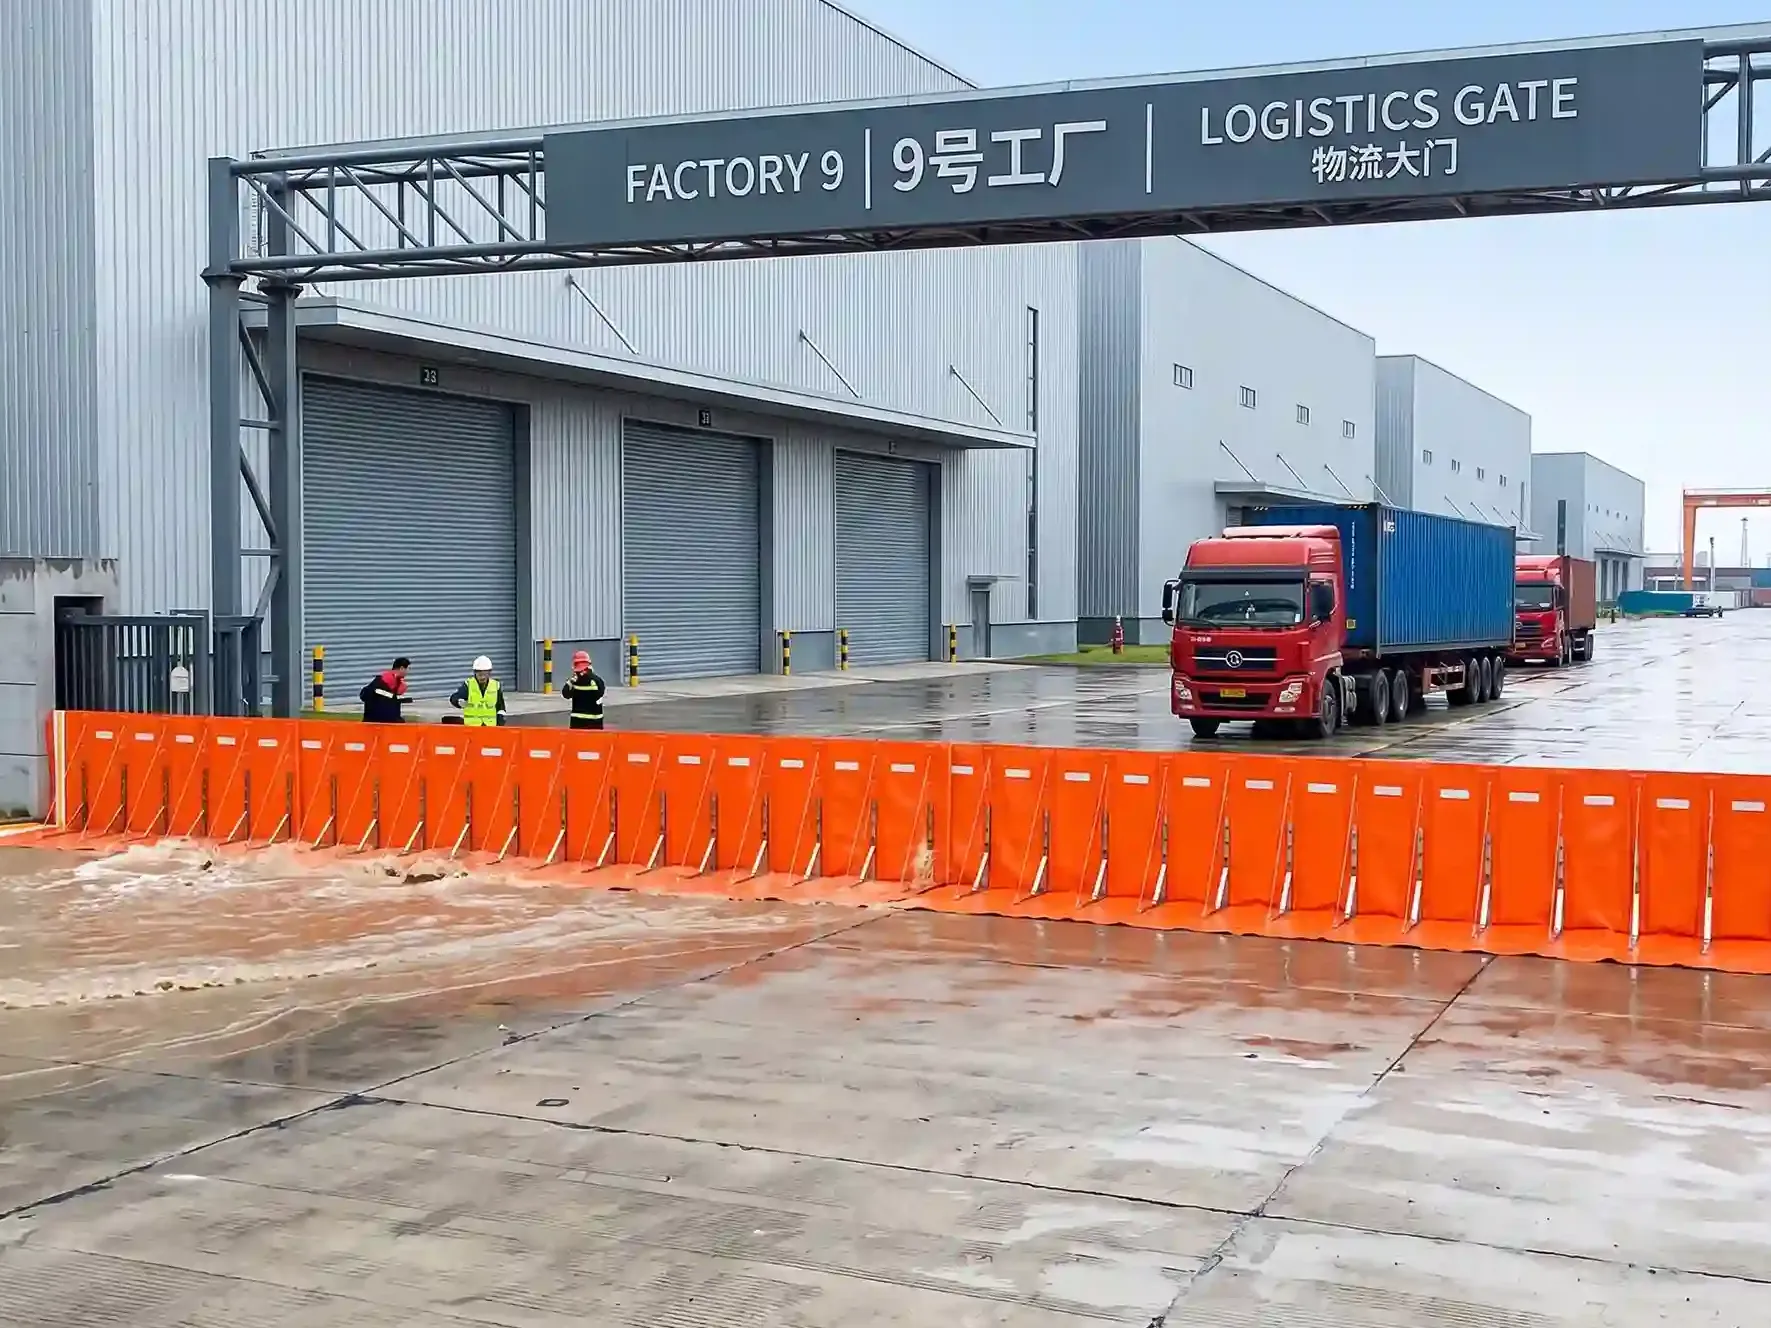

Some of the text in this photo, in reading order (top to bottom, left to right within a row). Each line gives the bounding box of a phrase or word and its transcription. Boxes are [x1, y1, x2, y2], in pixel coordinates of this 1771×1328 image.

[1202, 78, 1578, 145] LOGISTICS GATE
[626, 149, 844, 203] FACTORY 9
[893, 120, 1107, 193] 9号工厂
[1311, 139, 1458, 184] 物流大门
